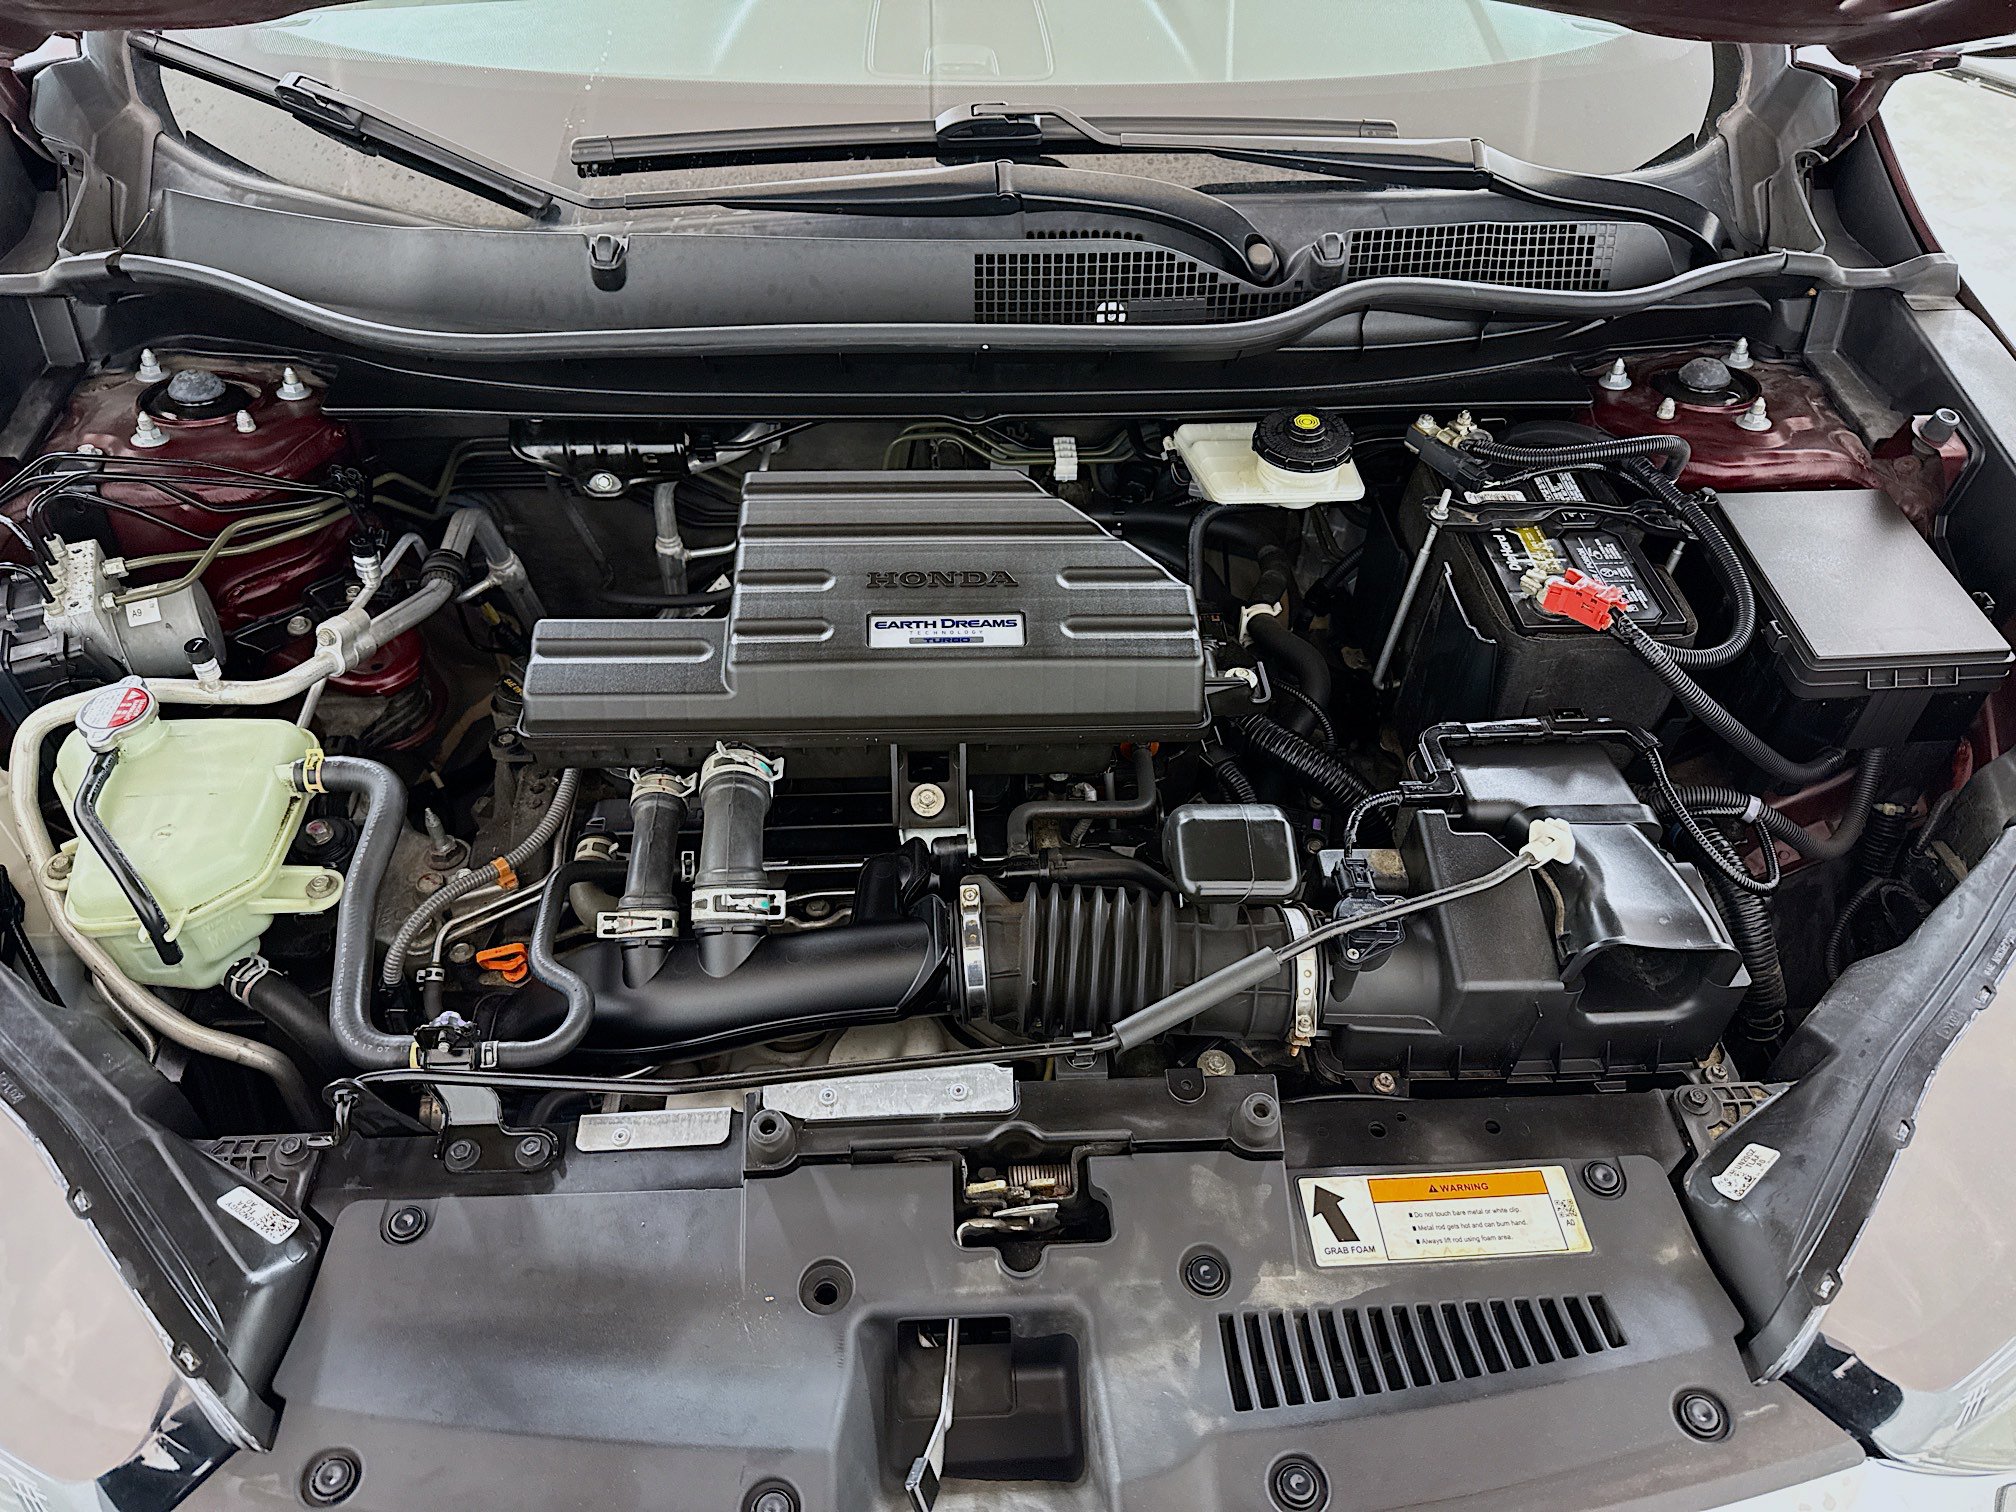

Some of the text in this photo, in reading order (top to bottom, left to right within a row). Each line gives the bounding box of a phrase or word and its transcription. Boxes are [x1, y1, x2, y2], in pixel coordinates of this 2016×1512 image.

[1493, 534, 1522, 571] DieHard
[866, 570, 1019, 589] HONDA
[132, 608, 142, 618] A9
[874, 618, 1018, 630] EARTH DREAMS
[1439, 1182, 1489, 1193] WARNING
[1447, 1223, 1459, 1231] gets
[1422, 1237, 1442, 1245] Always
[1324, 1245, 1376, 1255] GRAB FOAM
